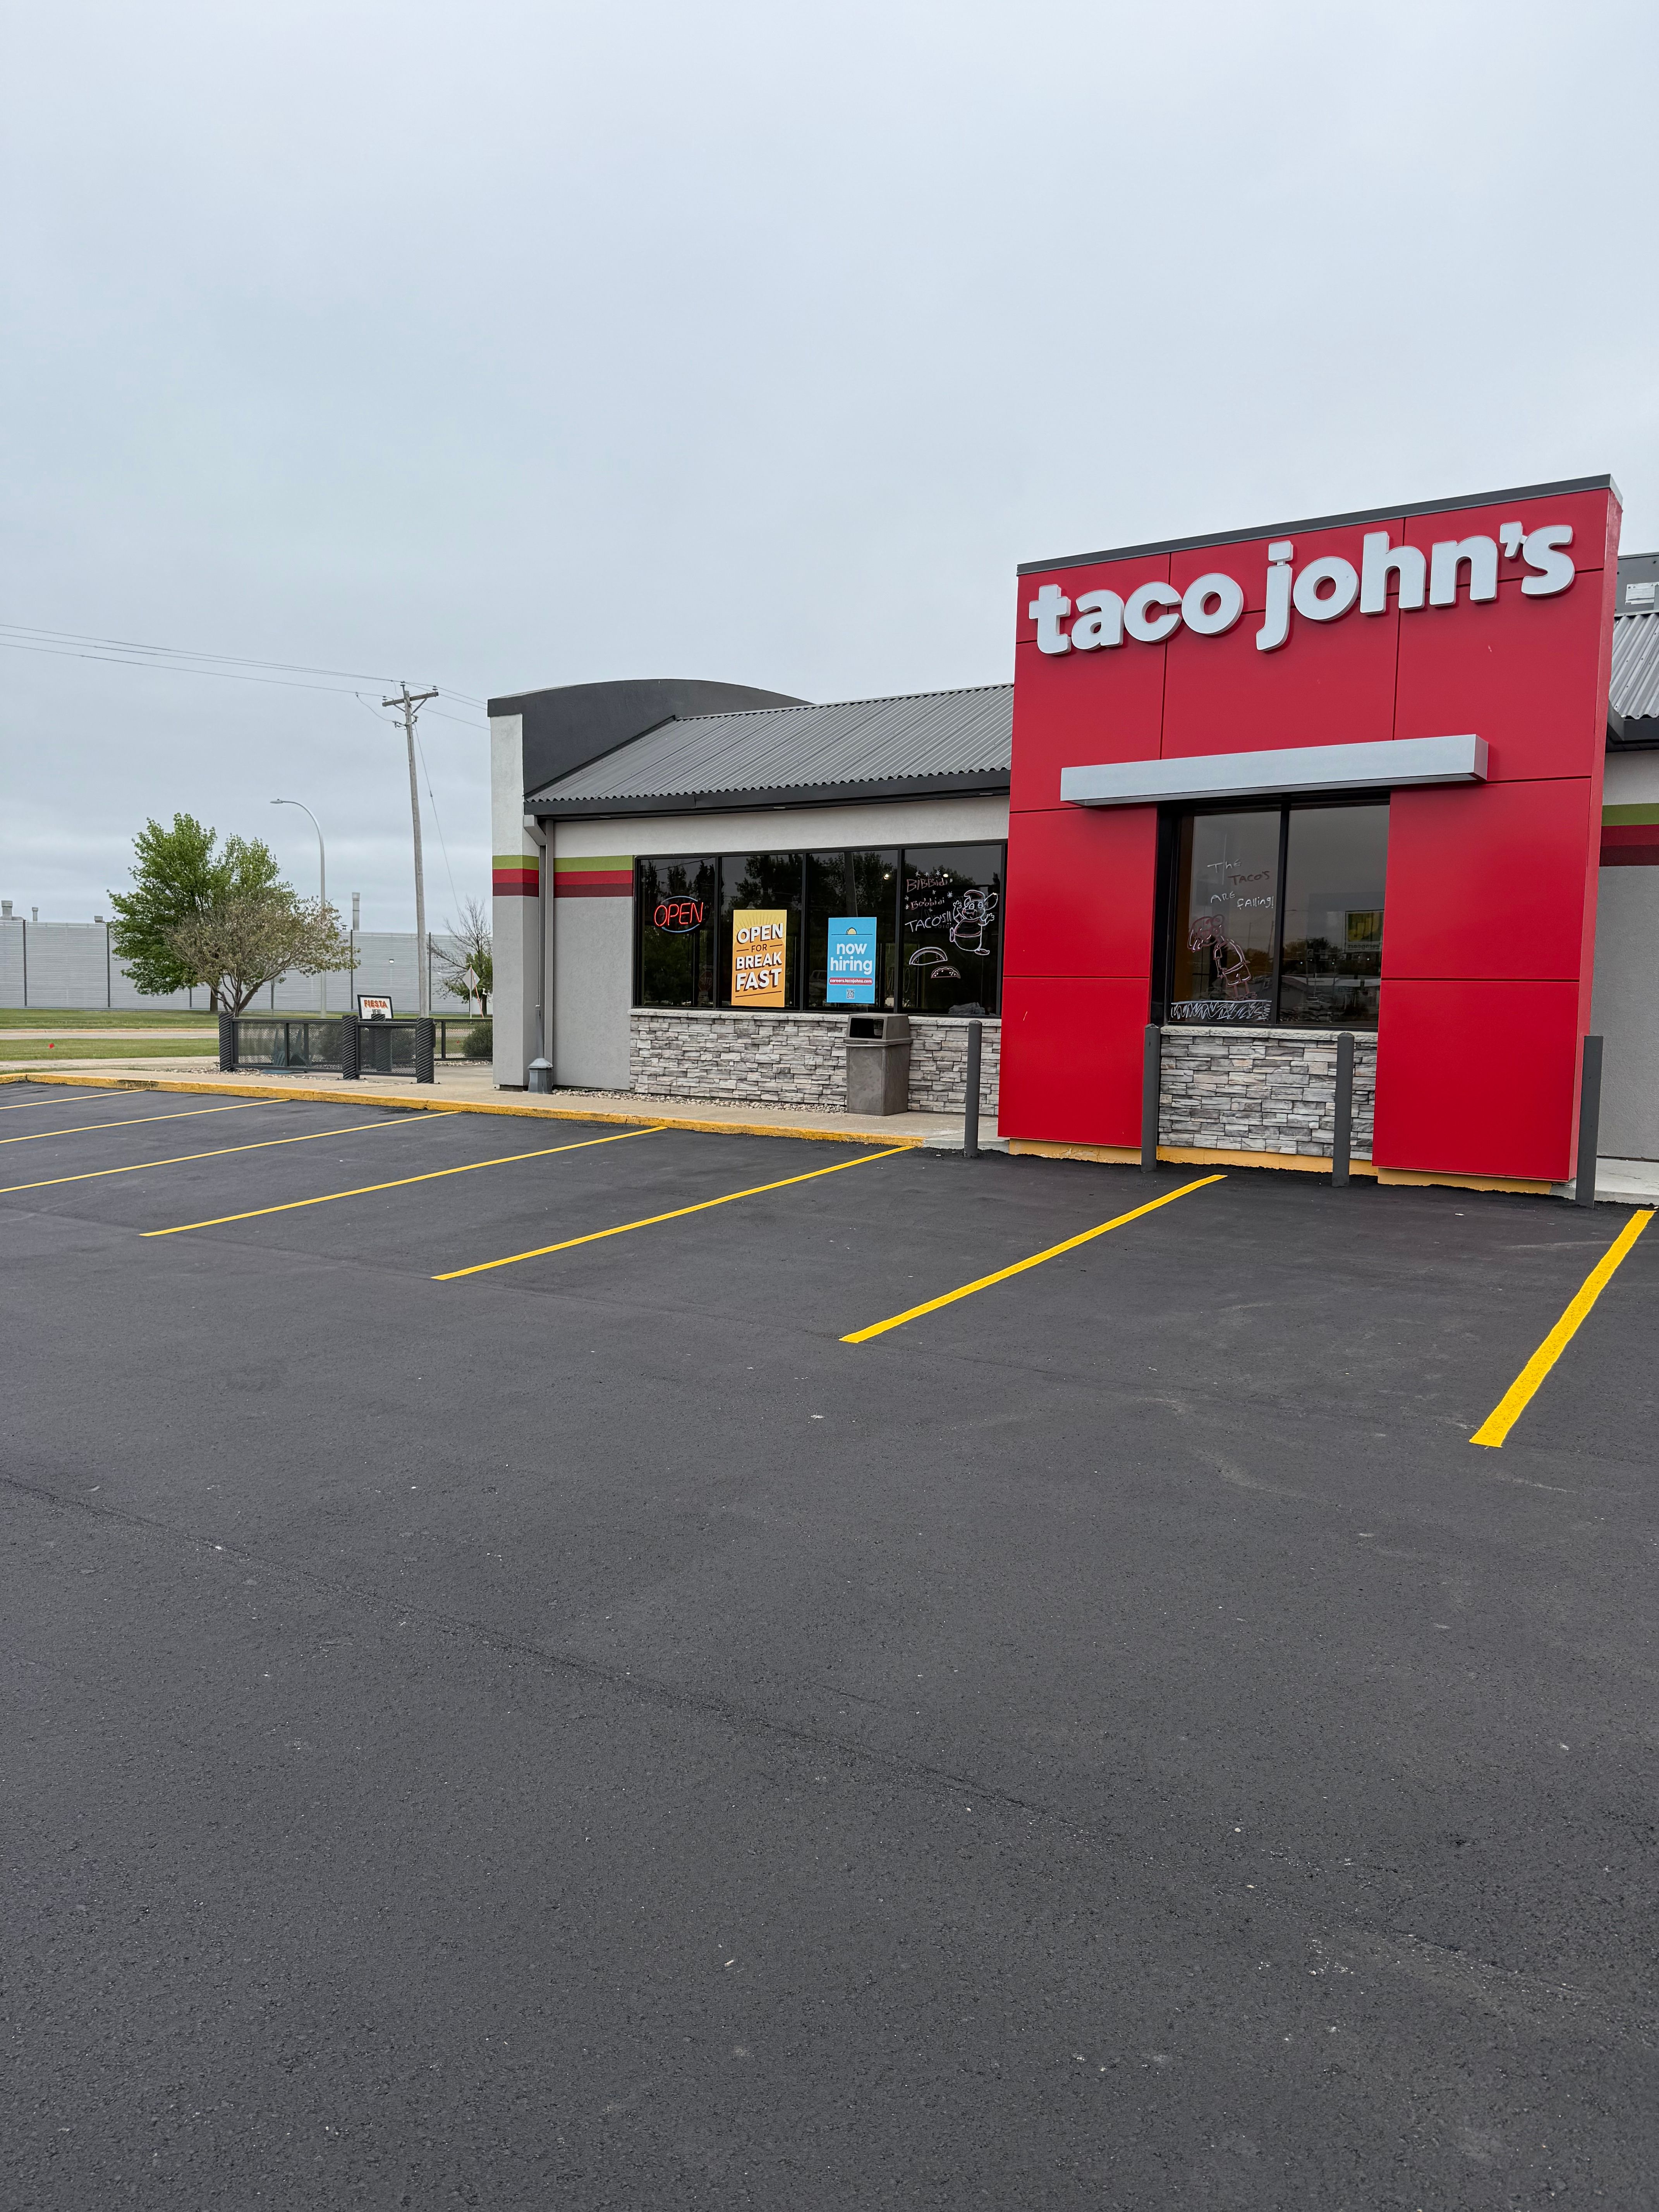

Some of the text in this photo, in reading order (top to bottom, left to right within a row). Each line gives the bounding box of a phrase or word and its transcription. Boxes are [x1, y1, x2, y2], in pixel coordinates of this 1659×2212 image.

[1029, 521, 1575, 655] taco john's
[654, 902, 704, 926] OPEN
[737, 922, 783, 944] OPEN
[751, 944, 767, 953] FOR
[836, 943, 867, 955] now
[736, 951, 783, 970] BREAK
[830, 956, 873, 975] hiring
[735, 968, 782, 993] FAST
[364, 1000, 388, 1009] FIESTA
